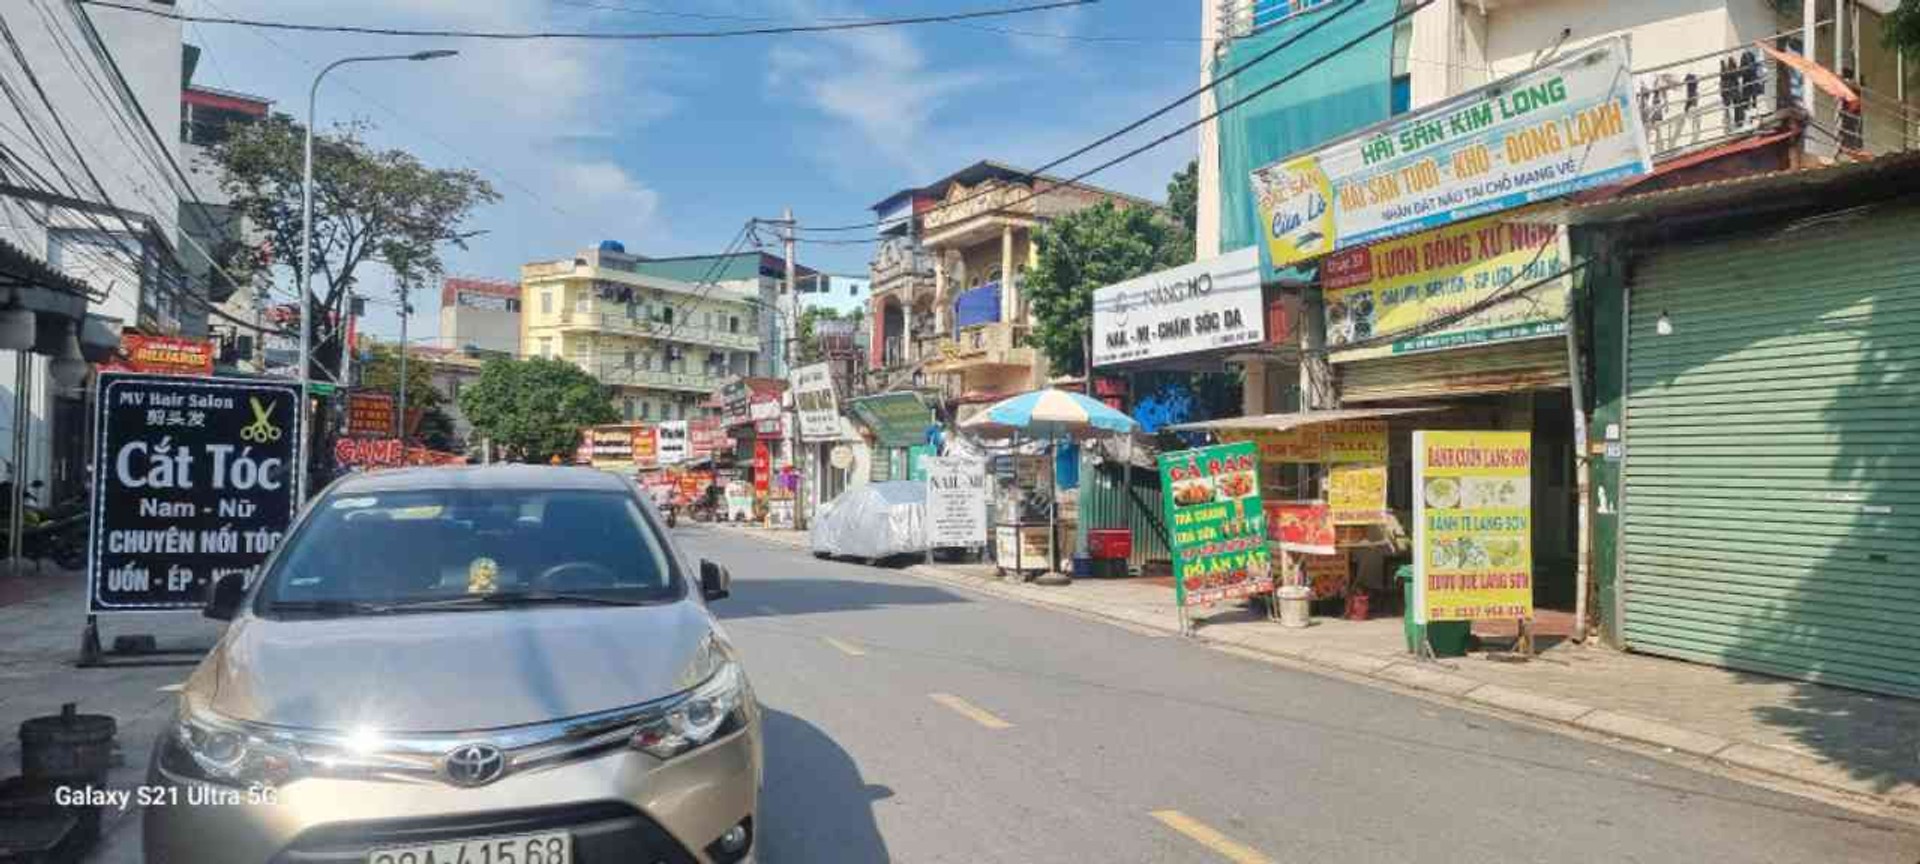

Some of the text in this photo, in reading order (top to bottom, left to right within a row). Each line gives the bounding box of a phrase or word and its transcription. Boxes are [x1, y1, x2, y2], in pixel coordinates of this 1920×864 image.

[1450, 103, 1493, 136] KIM
[1500, 76, 1567, 119] LONG
[1513, 166, 1555, 187] MANG
[1224, 308, 1242, 328] DA
[120, 391, 234, 409] MV Hair Salon
[116, 435, 282, 490] Cắt Tóc
[140, 498, 196, 518] Nam
[218, 498, 257, 518] Nữ
[108, 526, 195, 554] CHUYÊN
[201, 522, 239, 554] NỐI
[107, 560, 149, 591] UỐN
[168, 563, 194, 592] ÉP
